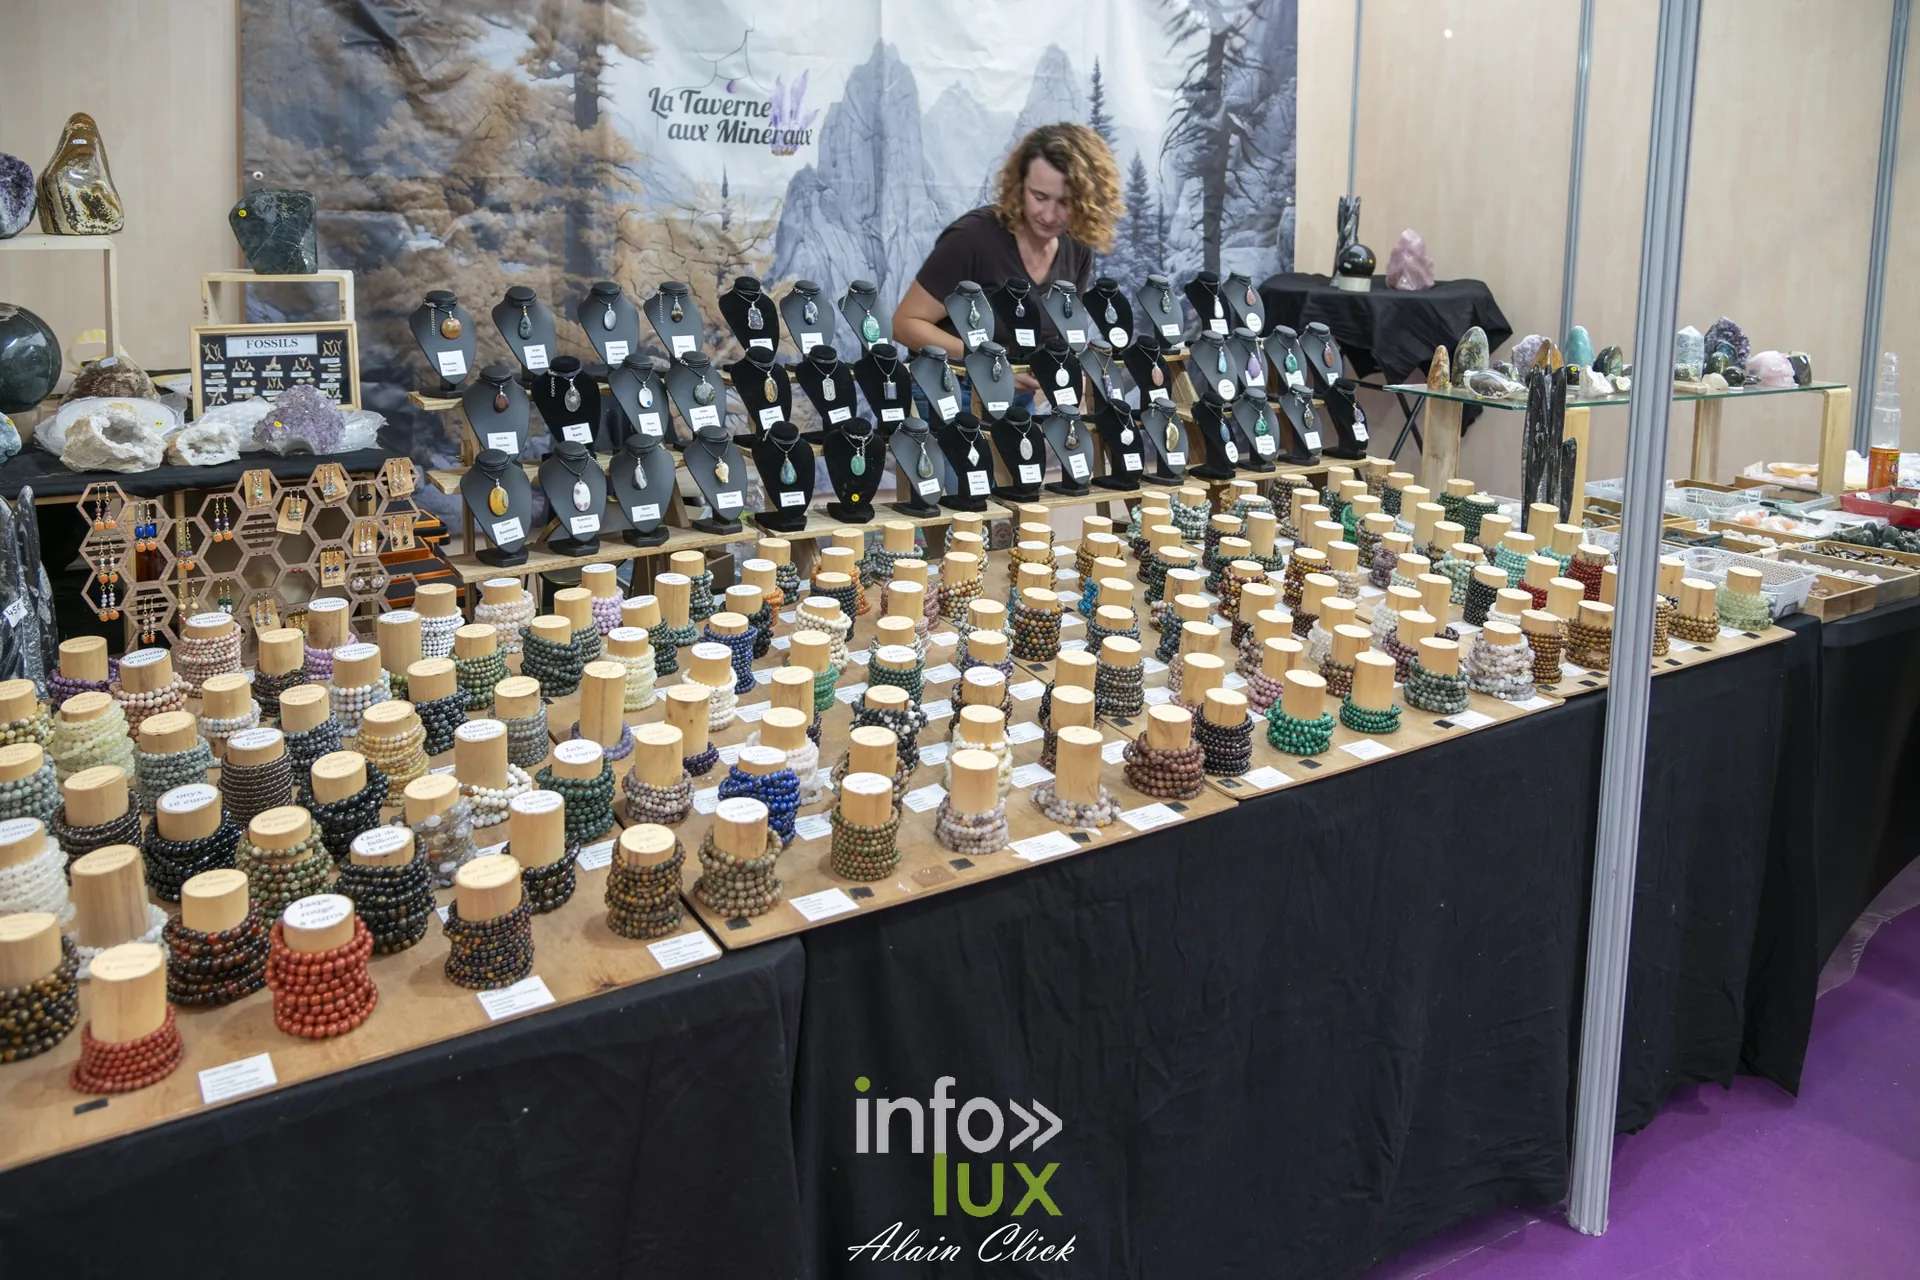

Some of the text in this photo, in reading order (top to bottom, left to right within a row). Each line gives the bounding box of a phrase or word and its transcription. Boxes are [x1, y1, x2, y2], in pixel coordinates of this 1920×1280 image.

[648, 86, 772, 119] La Taverne
[668, 118, 813, 146] aux Minéraux
[246, 338, 299, 349] FOSSILS
[565, 745, 585, 753] Jade
[574, 750, 599, 759] euros
[176, 790, 203, 800] onyx
[183, 795, 213, 805] euros
[360, 832, 382, 842] Oeil
[378, 840, 405, 850] euros
[299, 897, 331, 909] Jaspe
[301, 905, 335, 917] rouge
[310, 912, 345, 924] euros
